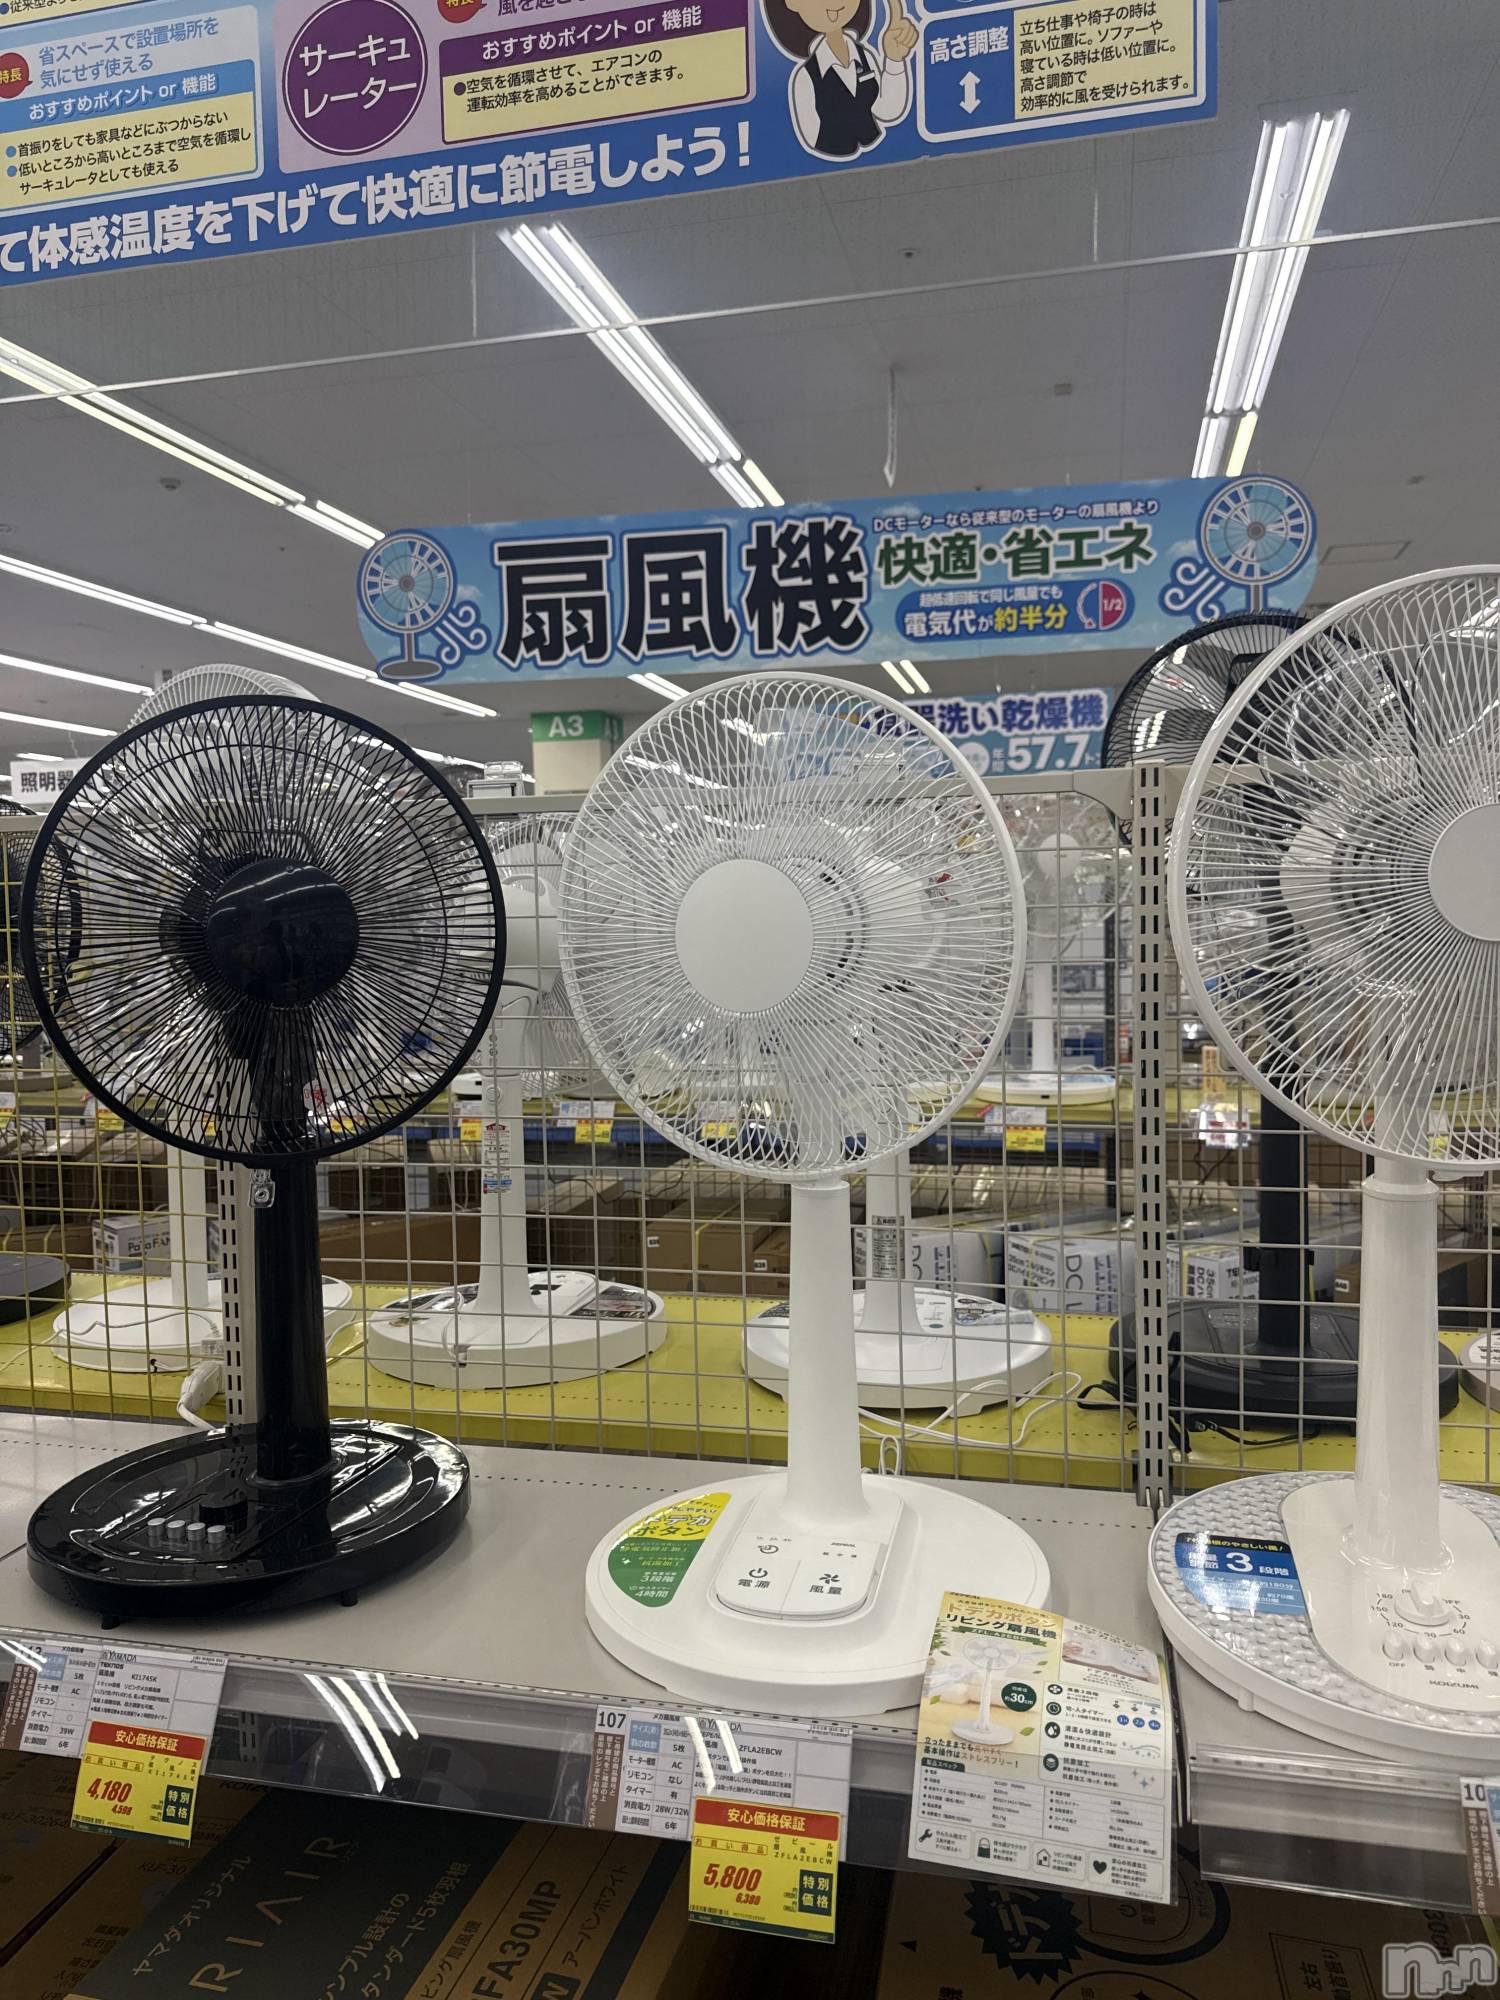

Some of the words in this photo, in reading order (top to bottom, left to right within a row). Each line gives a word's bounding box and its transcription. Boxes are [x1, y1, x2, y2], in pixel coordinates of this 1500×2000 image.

[1019, 2, 1157, 36] 立ち仕事や椅子の時は
[38, 17, 220, 67] 省スペースで設置場所を
[482, 19, 628, 60] おすすめポイント
[634, 18, 656, 35] or
[661, 5, 702, 31] 機能
[929, 25, 1010, 65] 高さ調整
[299, 35, 413, 78] サーキュ
[1019, 42, 1177, 74] 寝ている時は低い位置に。
[40, 53, 154, 89] 気にせず使える
[467, 49, 663, 92] 空気を循環させて、エアコンの
[1019, 70, 1088, 94] 高さ調節で
[29, 86, 154, 121] おすすめポイント
[159, 82, 177, 98] or
[182, 73, 217, 94] 機能
[303, 76, 418, 119] レーター
[467, 66, 686, 113] 運転効率を高めることができます。
[1019, 75, 1190, 112] 効率的に風を受けられます。
[17, 112, 229, 158] 首振りをしても家具などにぶつからない
[19, 129, 252, 177] 低いところから高いところまで空気を循環し
[19, 160, 180, 195] サーキュレータとしても使える
[876, 520, 1154, 586] 快適・省エネ
[494, 515, 868, 668] 扇風機
[1102, 599, 1123, 611] 1/2
[904, 603, 1069, 637] 電気代が約半分
[549, 714, 584, 738] A3
[1008, 733, 1091, 770] 57.7
[1225, 1552, 1254, 1573] 3
[1259, 1566, 1290, 1576] 段階
[738, 1577, 771, 1589] 電源
[946, 1613, 1057, 1640] リビング扇風機
[948, 1602, 1057, 1628] ドデカボタン
[31, 1709, 53, 1718] タイマー
[34, 1696, 56, 1706] リモコン
[597, 1711, 627, 1729] 107
[114, 1729, 179, 1752] 安心価格保証
[672, 1744, 685, 1753] 5枚
[627, 1770, 655, 1781] リモコン
[671, 1761, 683, 1770] AC
[86, 1777, 133, 1804] 4,180
[625, 1785, 653, 1794] タイマー
[668, 1775, 683, 1785] なし
[168, 1789, 190, 1805] 特別
[623, 1800, 651, 1811] 消費電力
[670, 1791, 678, 1800] 有
[165, 1805, 189, 1819] 価格
[727, 1808, 807, 1832] 安心価格保証
[664, 1821, 678, 1830] 6年
[774, 1851, 833, 1865] ZFLA2EBCW
[703, 1863, 763, 1892] 5,800
[802, 1875, 830, 1891] 特別
[801, 1892, 830, 1909] 価格
[132, 1855, 252, 1977] ヤマダオリジナル
[562, 1864, 630, 1968] アーバンホワイト
